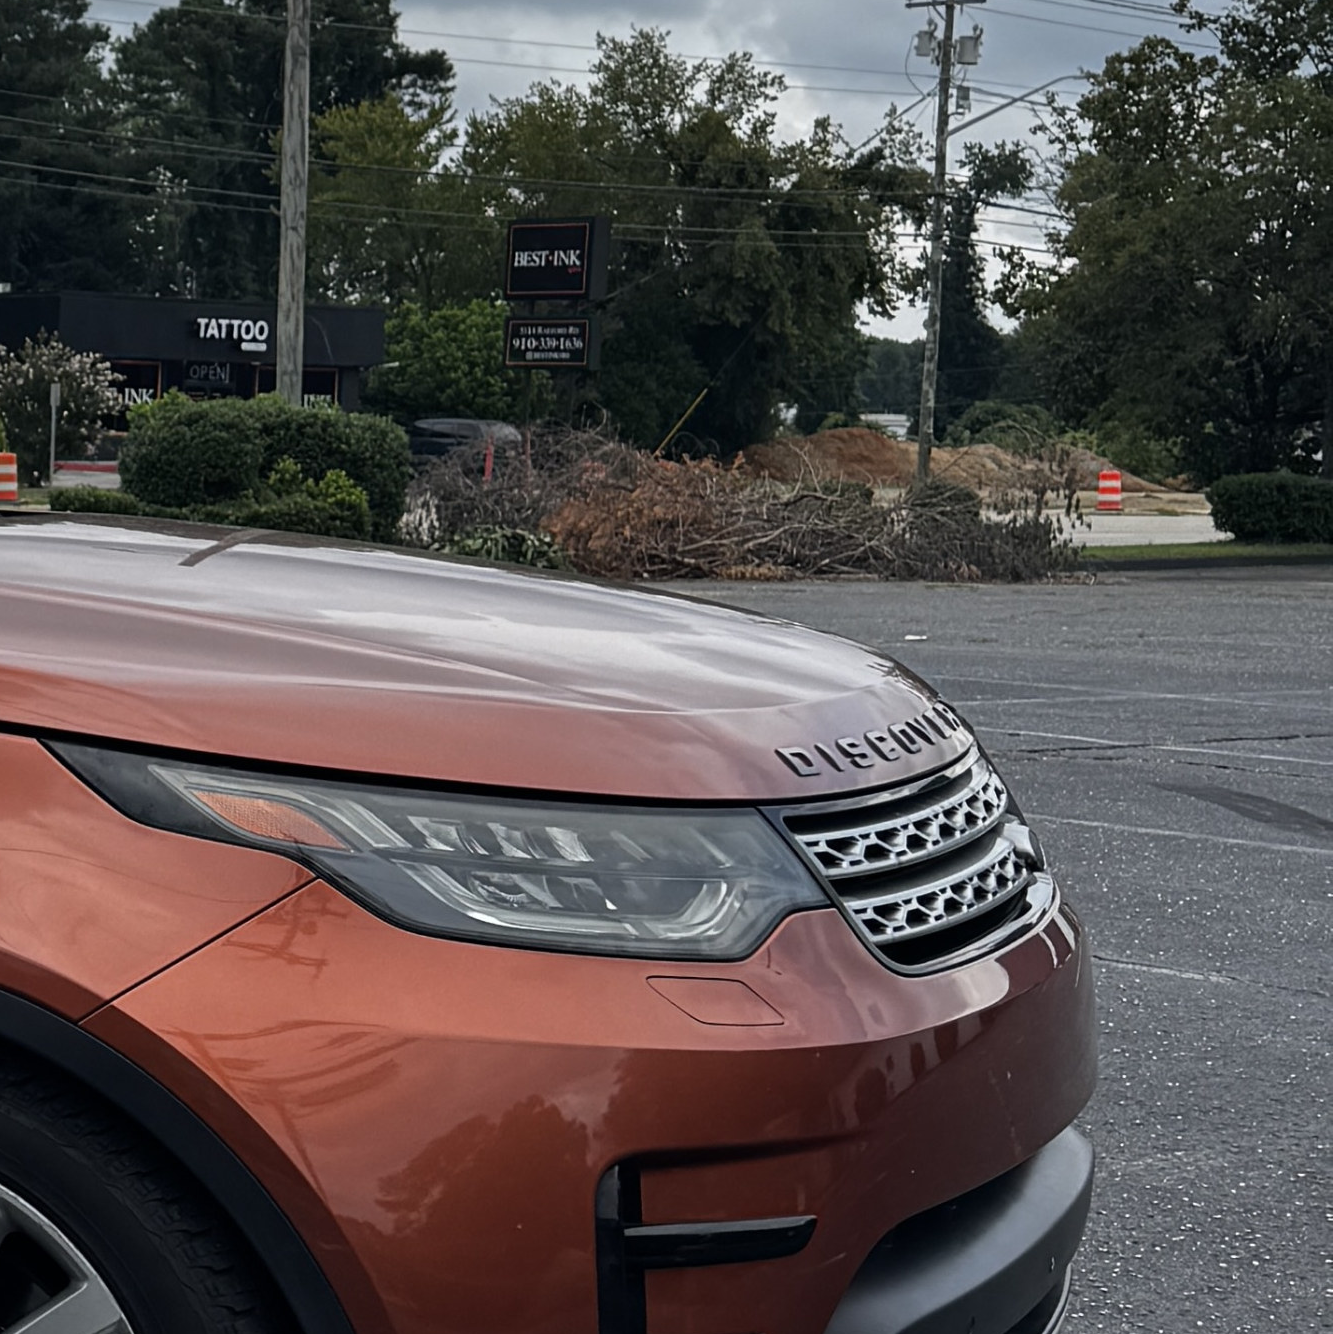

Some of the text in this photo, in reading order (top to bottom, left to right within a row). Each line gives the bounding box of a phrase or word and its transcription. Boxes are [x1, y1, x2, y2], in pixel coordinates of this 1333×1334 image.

[197, 318, 269, 341] TATTOO
[189, 364, 226, 380] OPEN
[774, 700, 962, 777] DISCOVER
